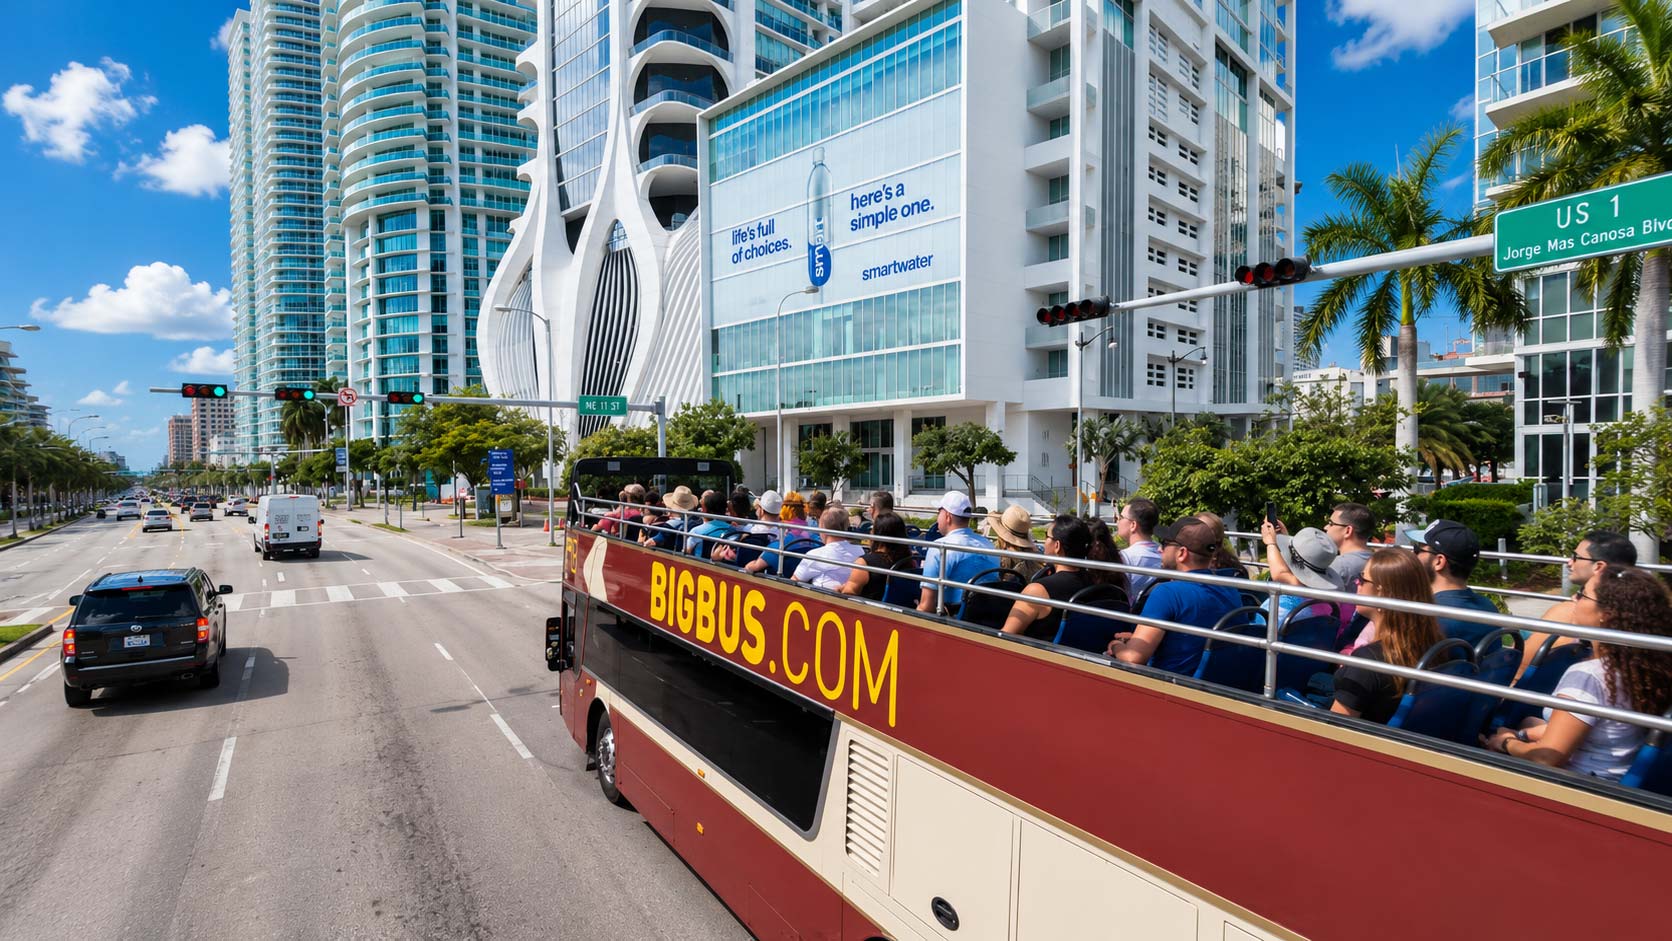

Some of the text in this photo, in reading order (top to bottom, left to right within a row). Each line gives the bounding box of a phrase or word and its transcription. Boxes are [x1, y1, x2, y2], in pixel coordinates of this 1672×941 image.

[850, 183, 905, 211] here's a
[850, 198, 934, 232] simple one.
[1556, 194, 1619, 229] US 1
[731, 218, 775, 246] life's full
[1503, 244, 1541, 261] Jorge
[1547, 238, 1575, 252] Mas
[1580, 226, 1635, 246] Canosa
[731, 238, 793, 265] of choices.
[862, 255, 934, 281] smartwater
[585, 401, 620, 411] NE 11 ST
[650, 560, 899, 728] BIGBUS.COM
